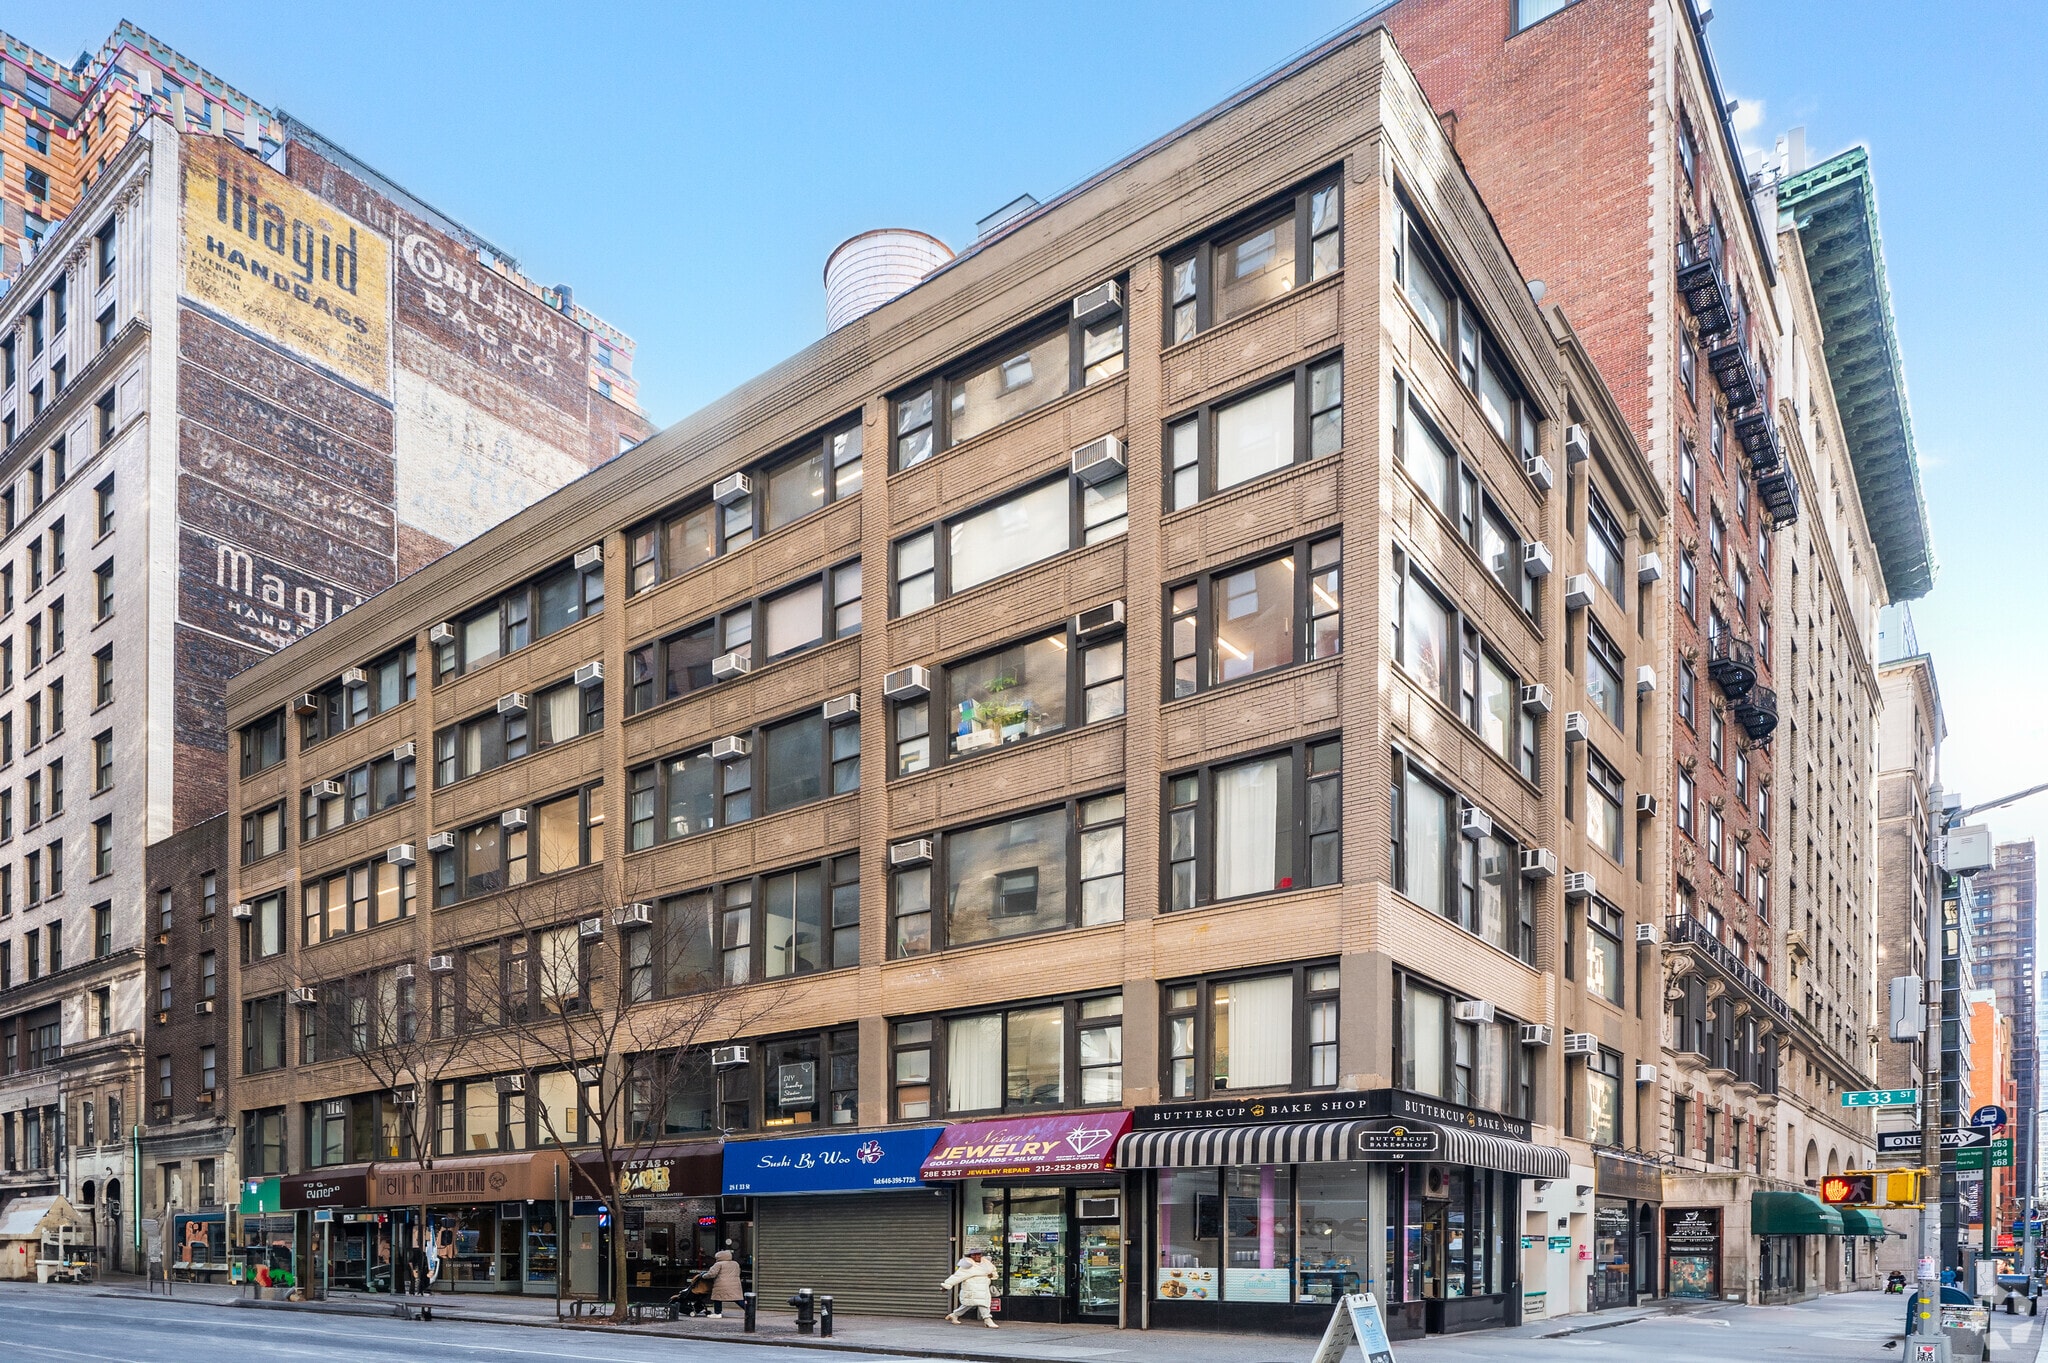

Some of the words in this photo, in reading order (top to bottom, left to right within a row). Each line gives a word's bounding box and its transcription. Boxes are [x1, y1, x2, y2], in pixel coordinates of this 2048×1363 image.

[206, 235, 369, 335] HANDBAGS
[423, 288, 500, 346] BAG
[783, 1082, 804, 1090] Jewelry
[1848, 1093, 1859, 1105] E
[1868, 1092, 1892, 1104] 33
[1154, 1107, 1246, 1121] BUTTERCUP
[1270, 1103, 1312, 1115] BAKE
[1321, 1099, 1367, 1111] SHOP
[1404, 1099, 1465, 1123] BUTTERCUP
[1477, 1116, 1500, 1131] BAKE
[1503, 1122, 1525, 1136] SHOP
[1893, 1136, 1921, 1146] ONE
[1940, 1133, 1974, 1143] WAY
[1992, 1139, 2008, 1148] x63
[934, 1140, 1062, 1161] JEWELRY
[1992, 1149, 2008, 1157] x64
[756, 1154, 791, 1169] Sushi
[794, 1152, 816, 1169] By
[818, 1151, 851, 1165] Woo
[959, 1157, 1006, 1165] DIAMONDS
[1992, 1158, 2008, 1167] x68
[923, 1170, 940, 1178] 28E
[941, 1169, 963, 1177] 33ST
[966, 1168, 1002, 1176] JEWELRY
[1003, 1167, 1031, 1175] REPAIR
[1035, 1162, 1100, 1173] 212-252-8978
[620, 1166, 670, 1194] BARBER
